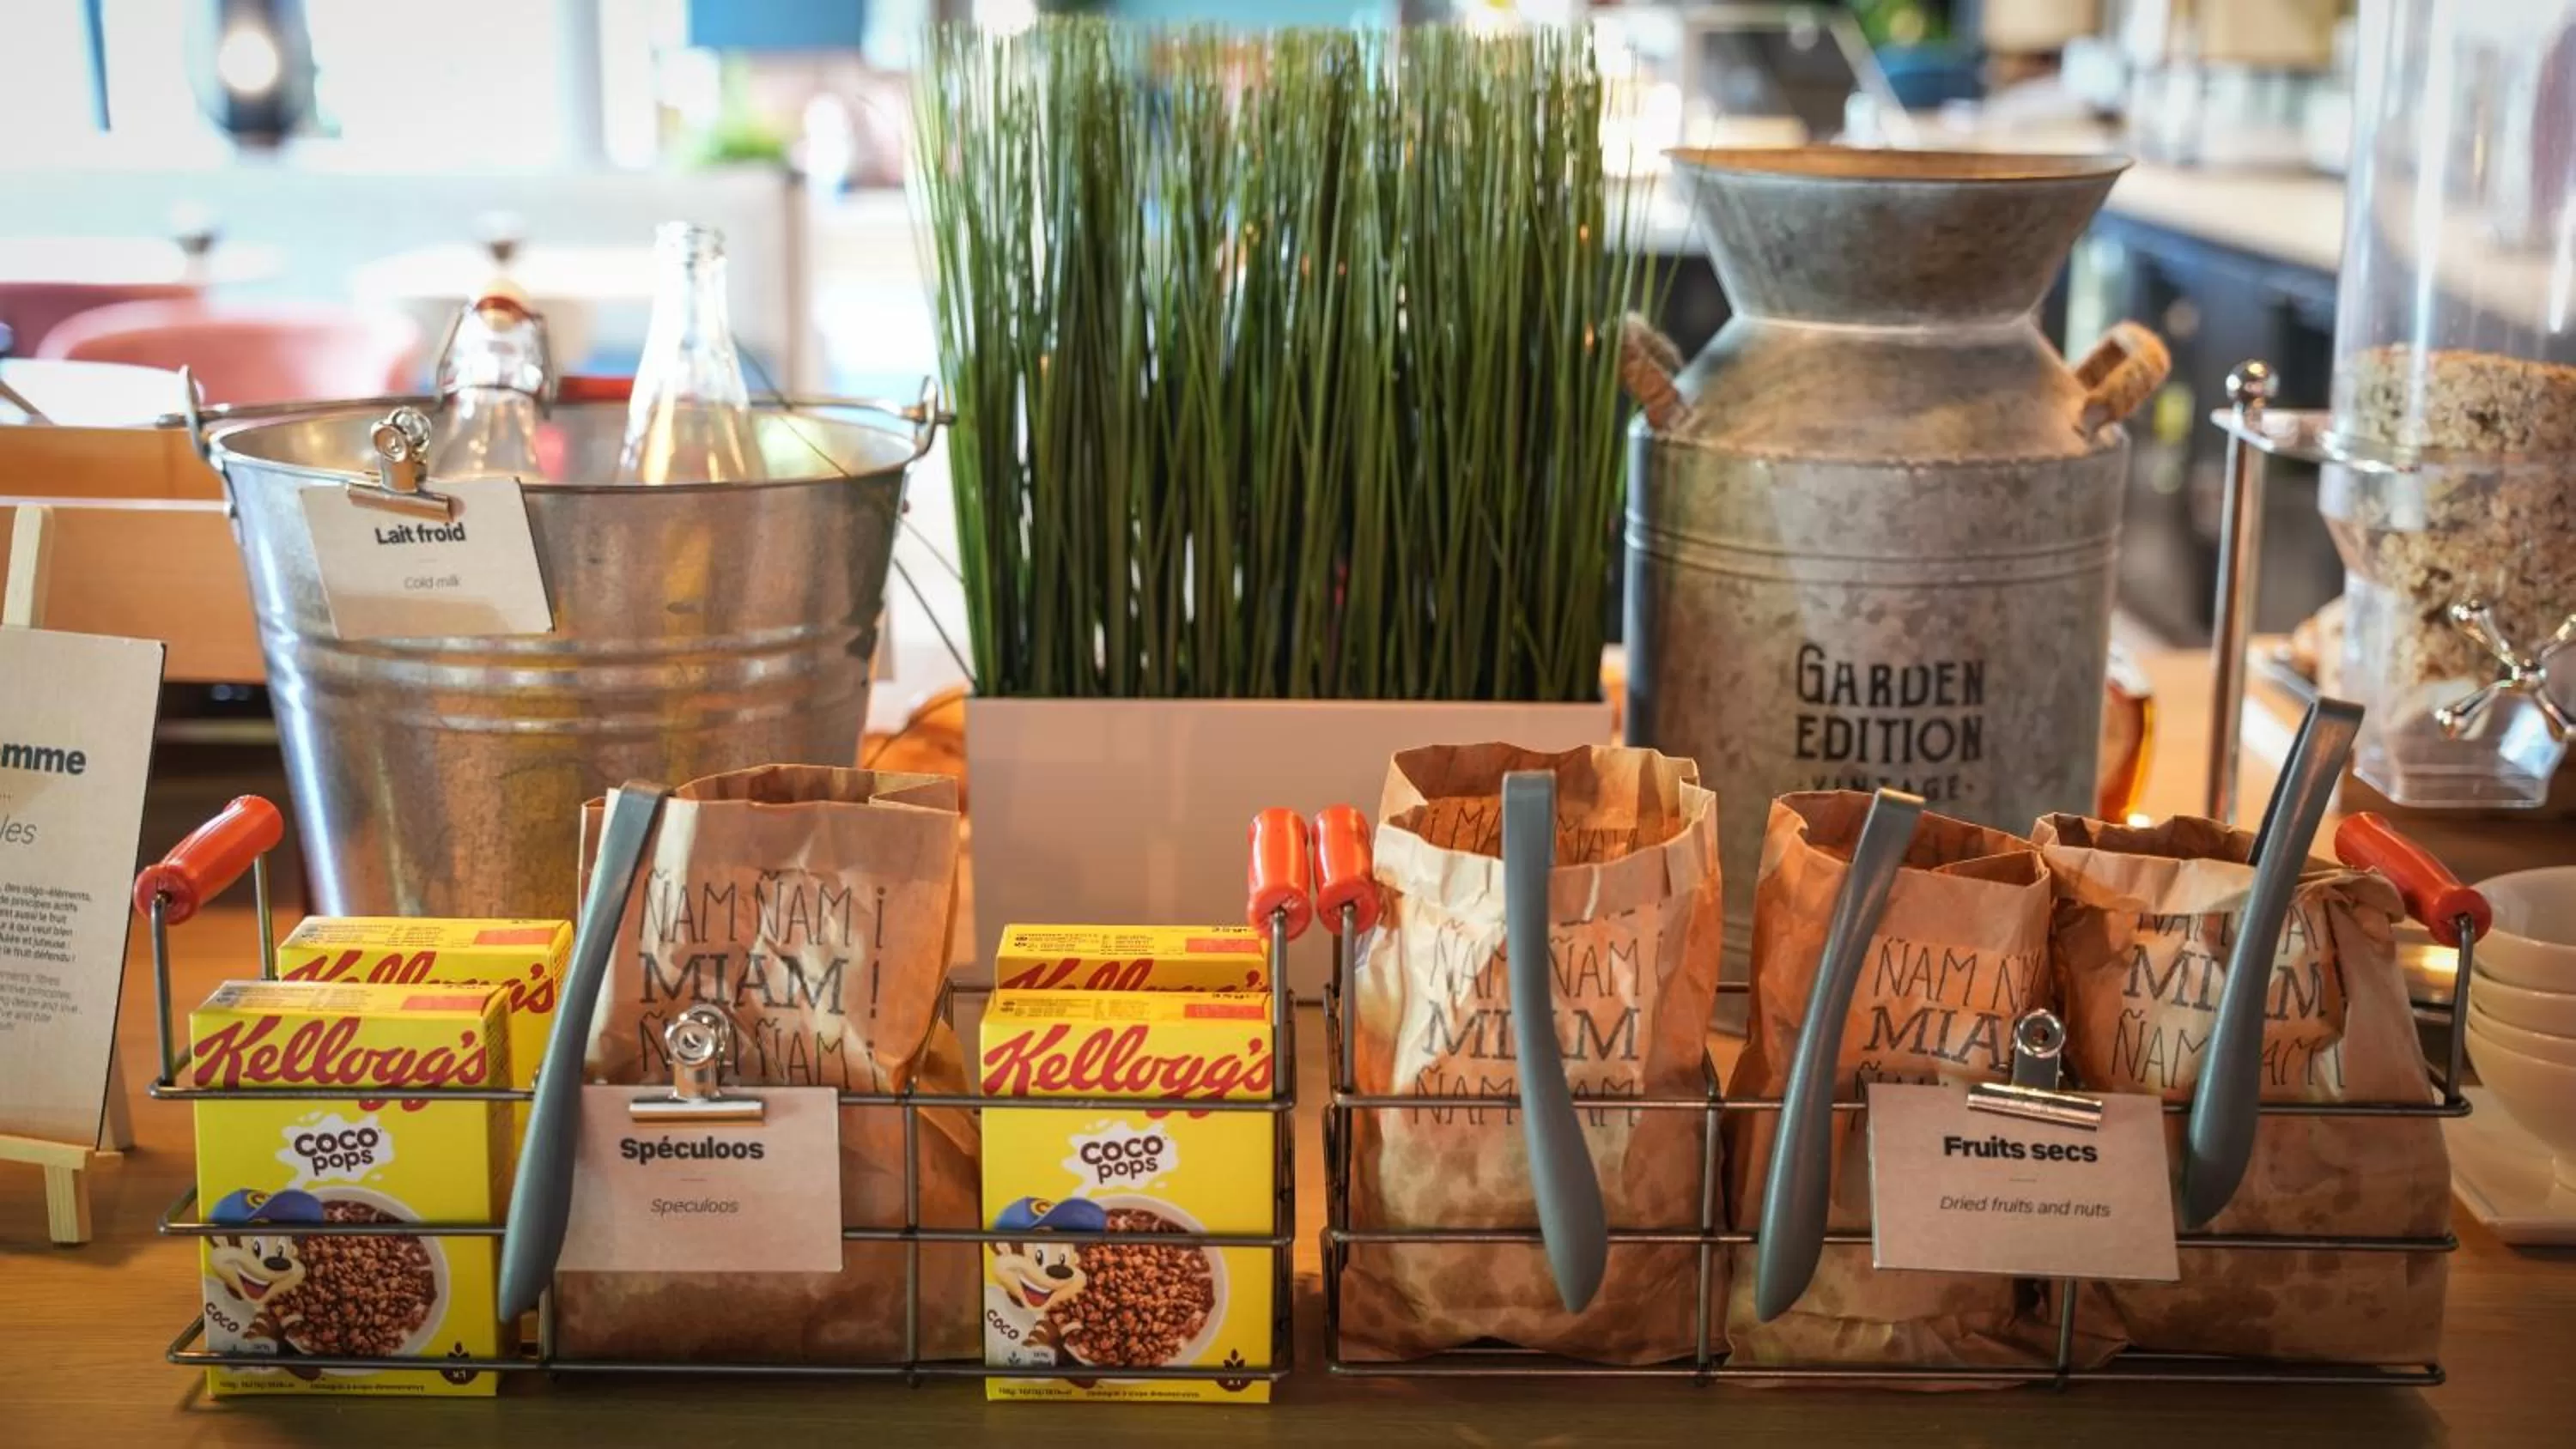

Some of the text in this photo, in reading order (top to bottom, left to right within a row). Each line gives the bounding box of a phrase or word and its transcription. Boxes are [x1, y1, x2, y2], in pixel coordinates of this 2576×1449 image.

[374, 522, 466, 545] Lait froid
[404, 573, 462, 591] Cold milk
[1797, 642, 1985, 707] GARDEN
[1795, 714, 1984, 764] EDITION
[639, 952, 849, 1016] MIAM
[1862, 1005, 2013, 1074] MIA
[312, 1147, 374, 1176] pops
[620, 1135, 765, 1165] Spéculoos
[1943, 1135, 2099, 1164] Fruits secs
[1097, 1156, 1158, 1185] pops
[650, 1197, 739, 1216] Speculoos
[1940, 1195, 2111, 1219] Dried fruits and nuts
